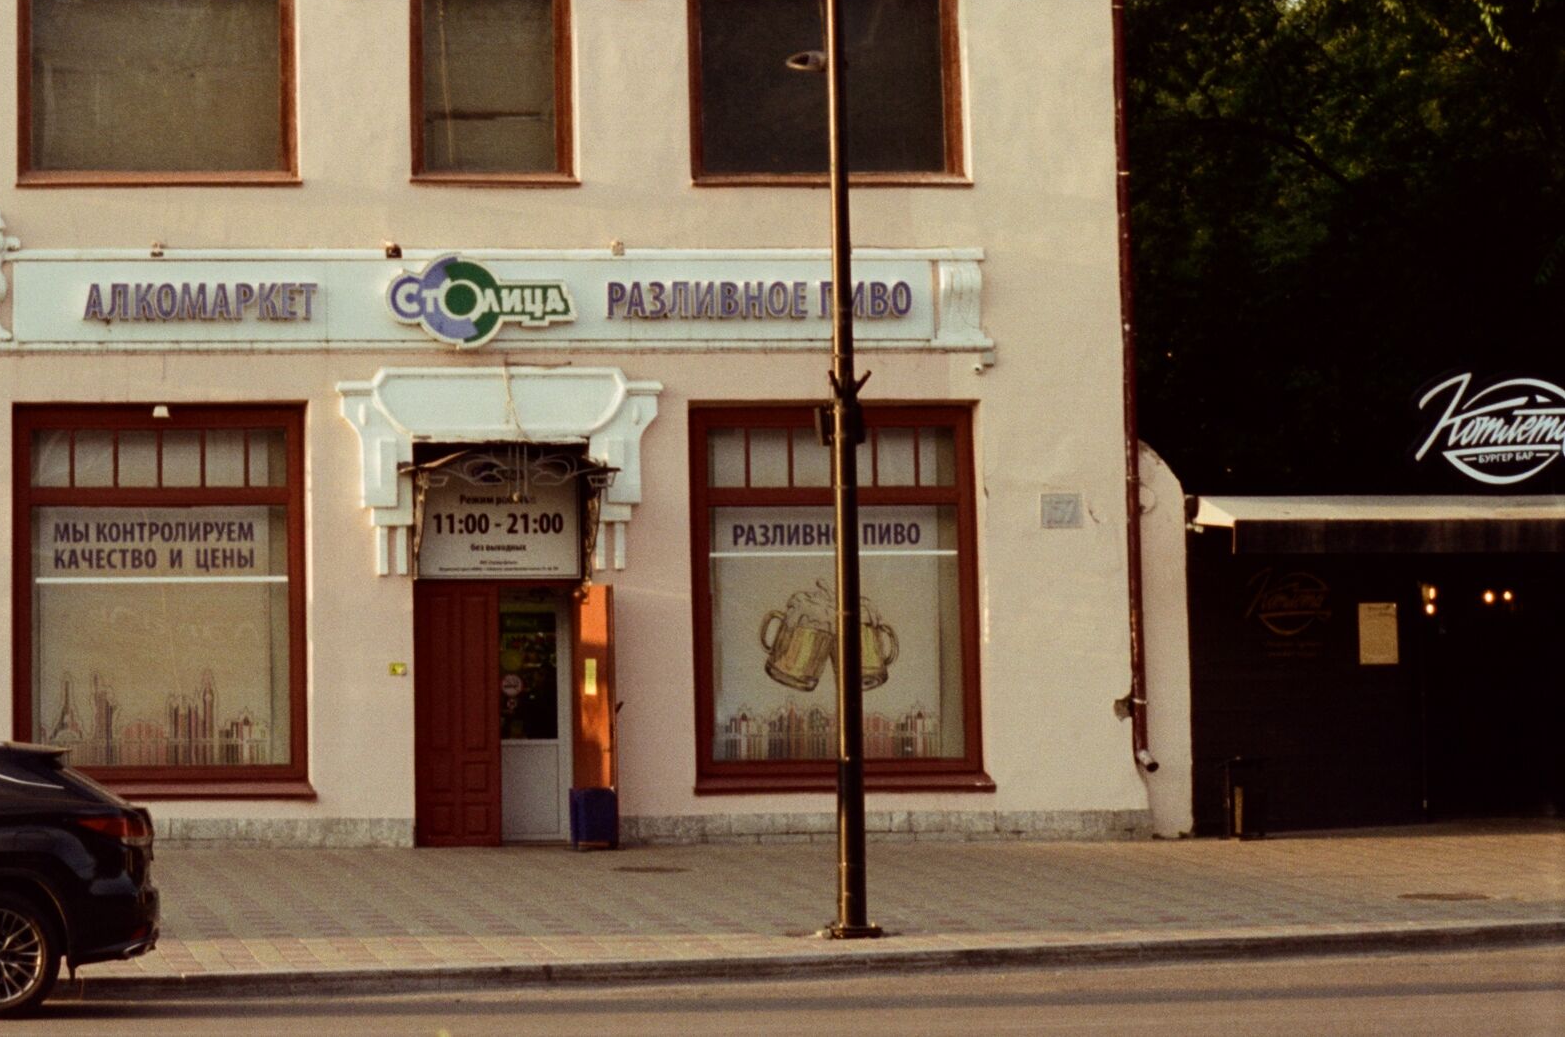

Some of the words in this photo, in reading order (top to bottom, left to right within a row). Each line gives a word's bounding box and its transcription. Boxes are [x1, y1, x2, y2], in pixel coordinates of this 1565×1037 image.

[83, 283, 317, 320] АЛКОМАРКЕТ
[607, 281, 808, 318] РАЗЛИВНОЕ
[1478, 452, 1515, 463] БУРГЕР
[1516, 450, 1534, 461] БАР
[54, 522, 90, 543] МЫ
[96, 522, 254, 543] КОНТРОЛИРУЕМ
[433, 513, 490, 534] 11:00
[507, 513, 564, 534] 21:00
[733, 524, 837, 546] РАЗЛИВН
[862, 523, 920, 544] ПИВО
[54, 549, 157, 570] КАЧЕСТВО
[170, 549, 183, 569] И
[196, 548, 254, 572] ЦЕНЫ
